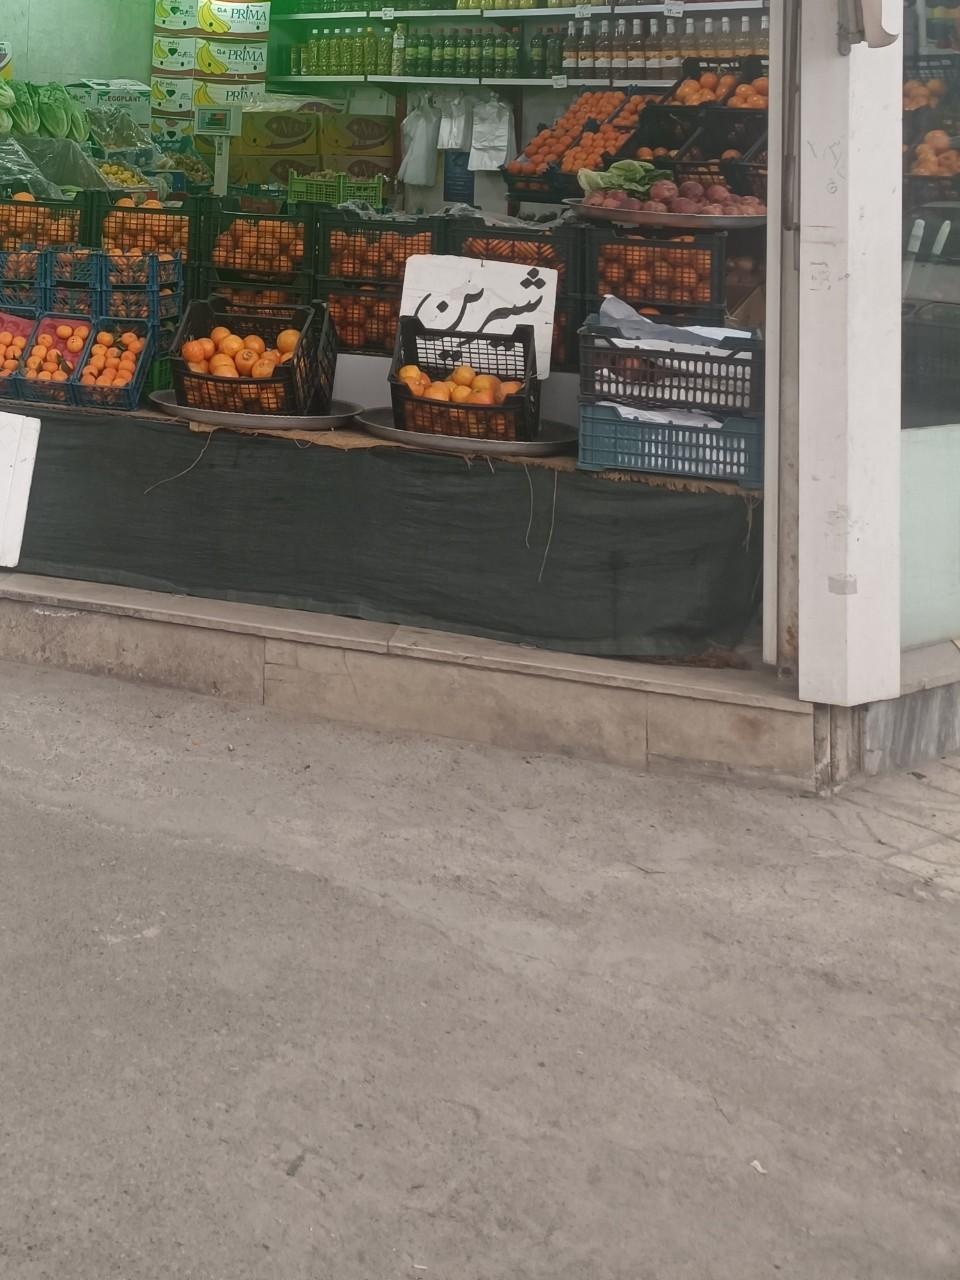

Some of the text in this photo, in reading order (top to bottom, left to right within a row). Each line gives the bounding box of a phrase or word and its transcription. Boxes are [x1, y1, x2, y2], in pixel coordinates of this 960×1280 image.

[231, 4, 267, 22] PRIMA
[228, 45, 265, 62] PRIMA
[413, 267, 547, 362] شیرین
